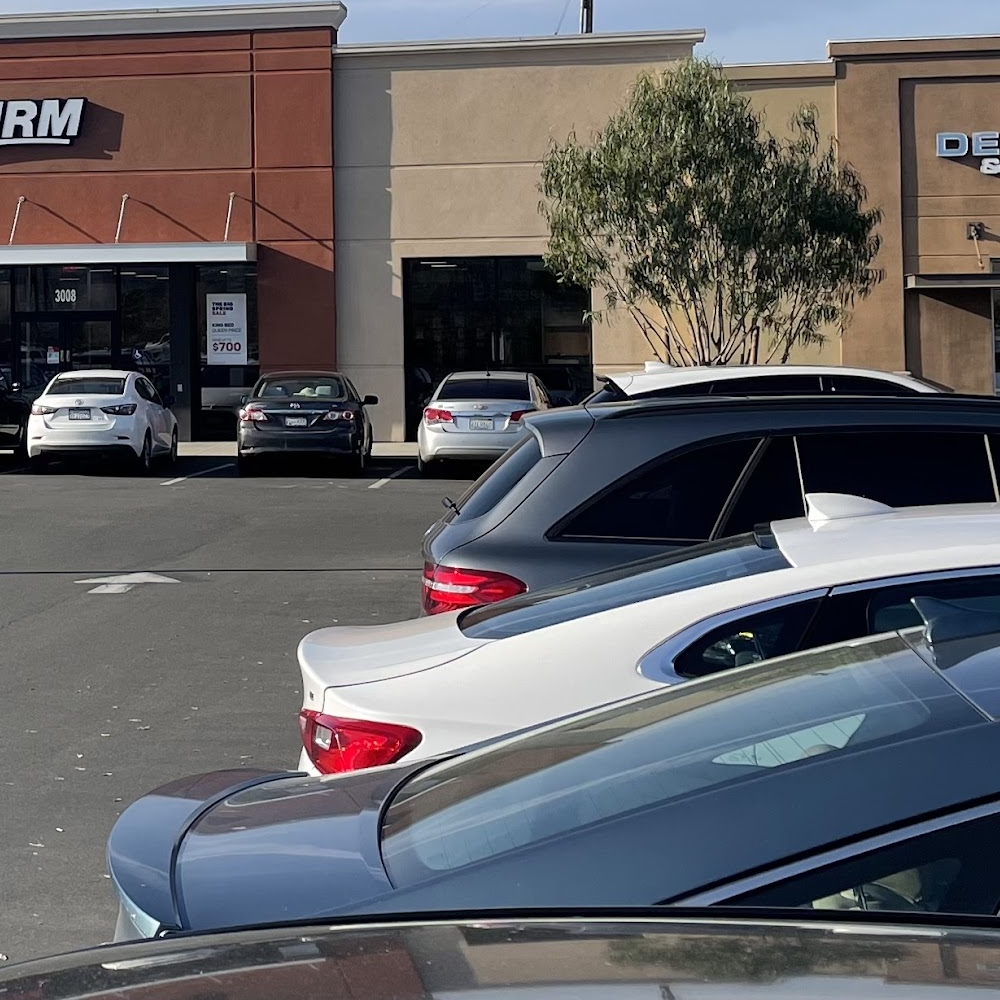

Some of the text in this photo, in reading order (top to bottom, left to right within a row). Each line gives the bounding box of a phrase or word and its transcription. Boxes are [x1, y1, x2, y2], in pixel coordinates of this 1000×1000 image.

[935, 130, 1000, 157] DE
[979, 157, 1000, 175] &
[54, 288, 77, 303] 3008
[212, 342, 241, 352] $700
